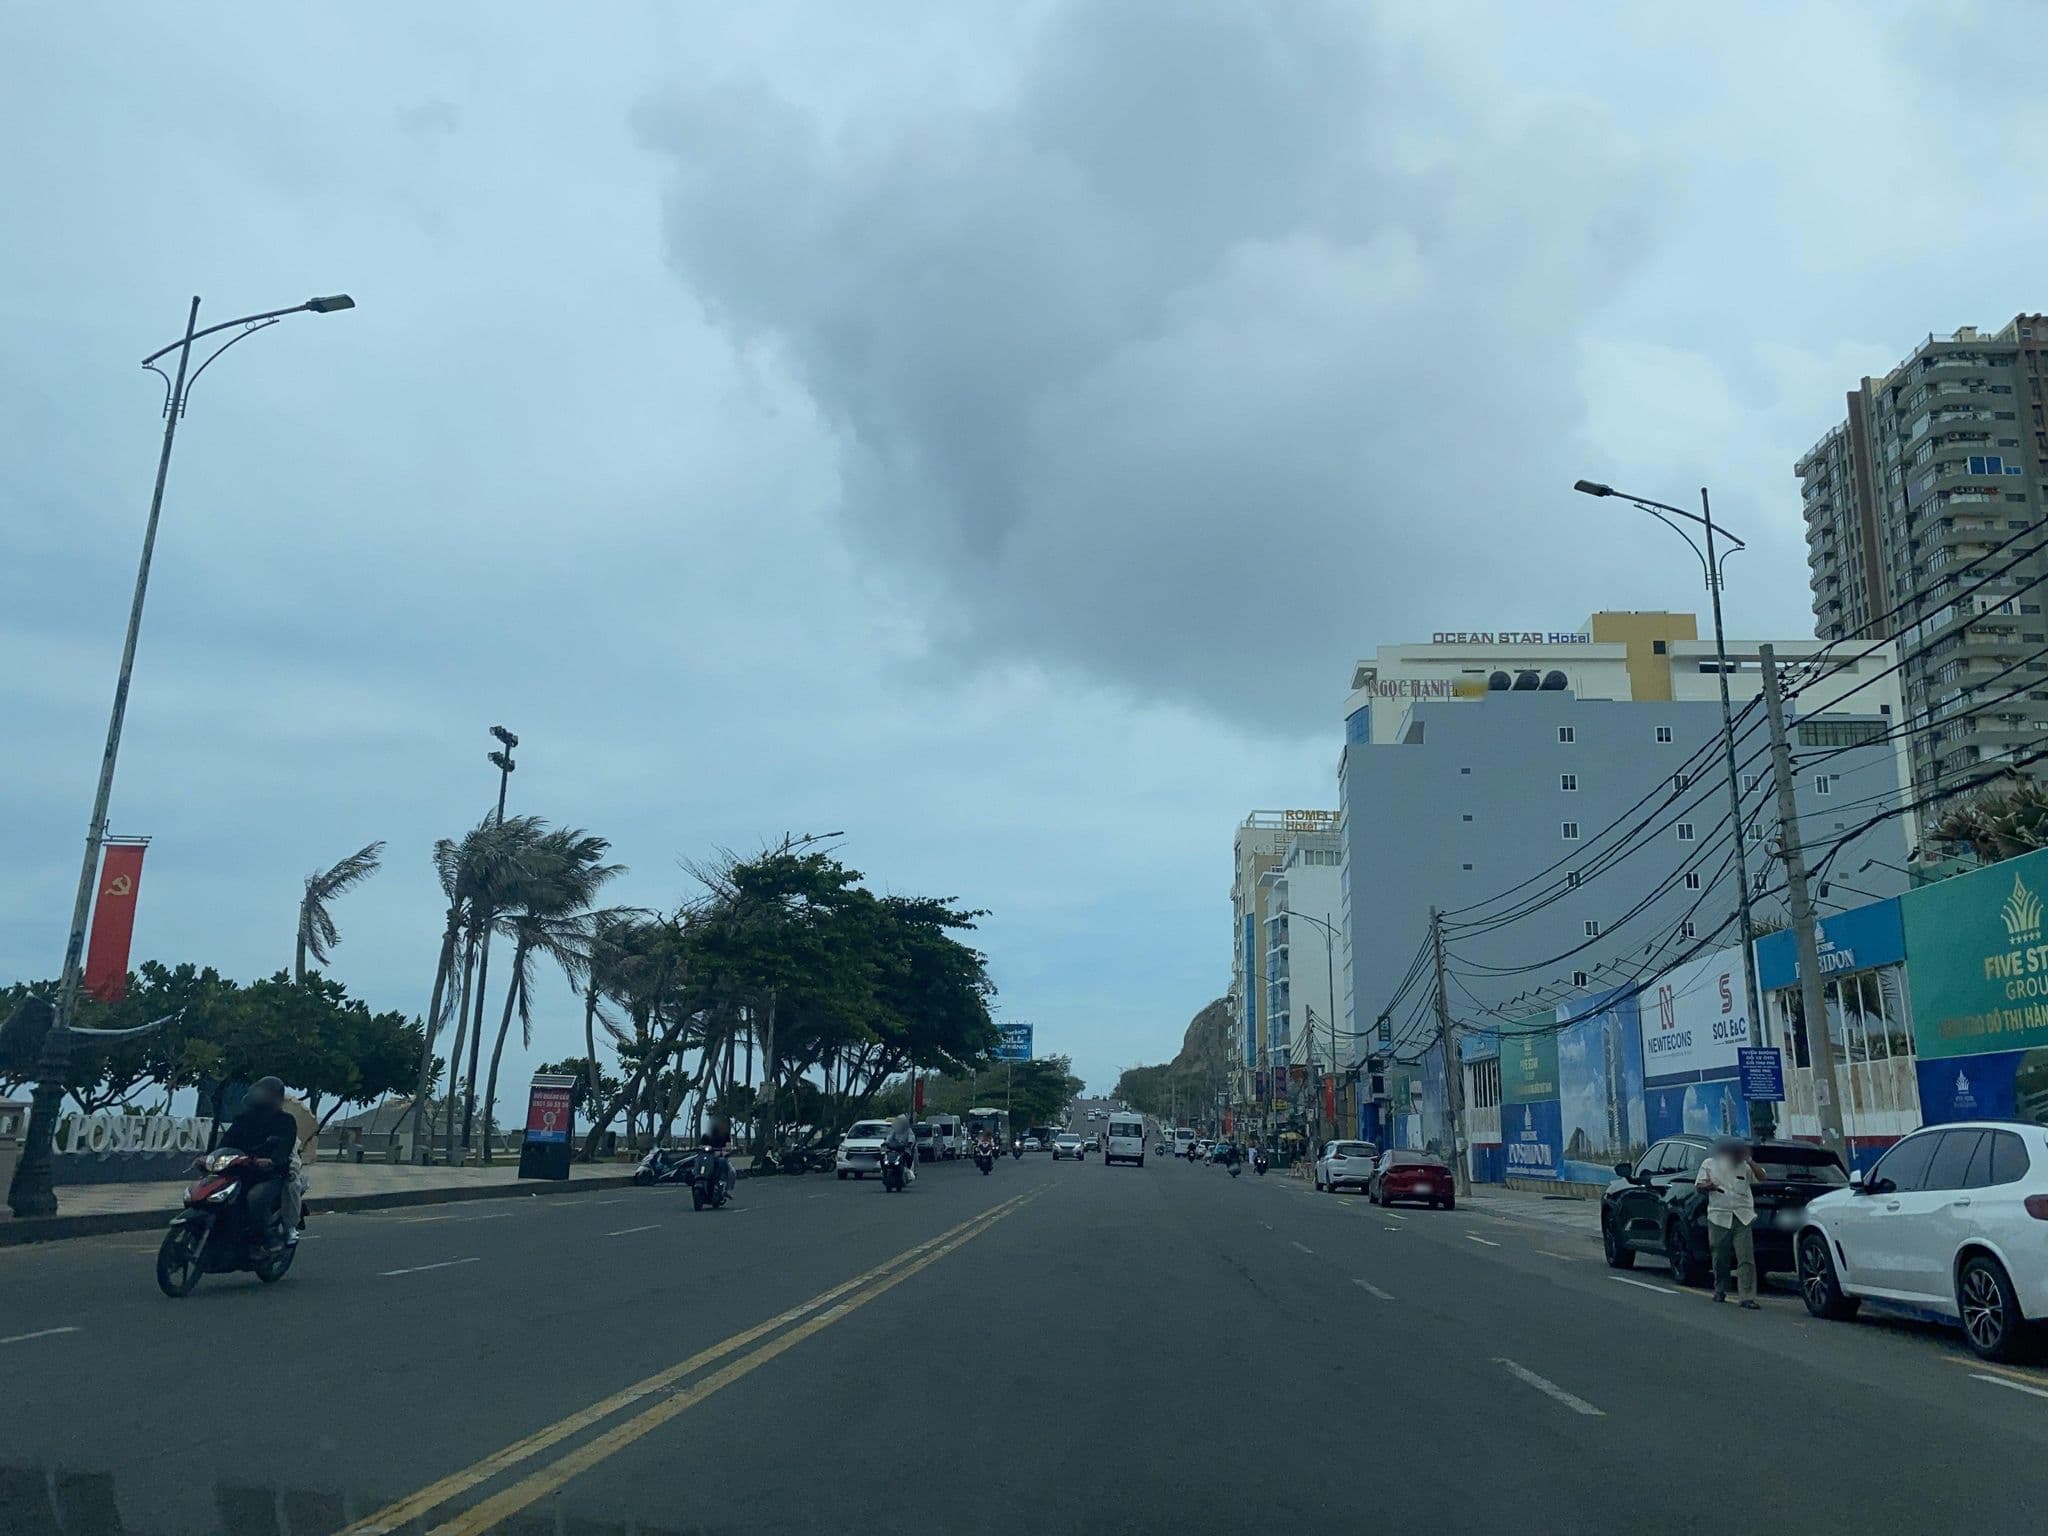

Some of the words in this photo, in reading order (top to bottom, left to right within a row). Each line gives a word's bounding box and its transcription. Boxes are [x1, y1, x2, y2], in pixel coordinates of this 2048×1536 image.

[1433, 632, 1494, 645] OCEAN
[1498, 632, 1543, 645] STAR
[1548, 632, 1590, 645] Hotel
[1286, 821, 1318, 832] Hotel
[1985, 951, 2022, 981] FIVE
[1712, 1020, 1729, 1040] SOL
[1648, 1031, 1692, 1054] NEWTECONS
